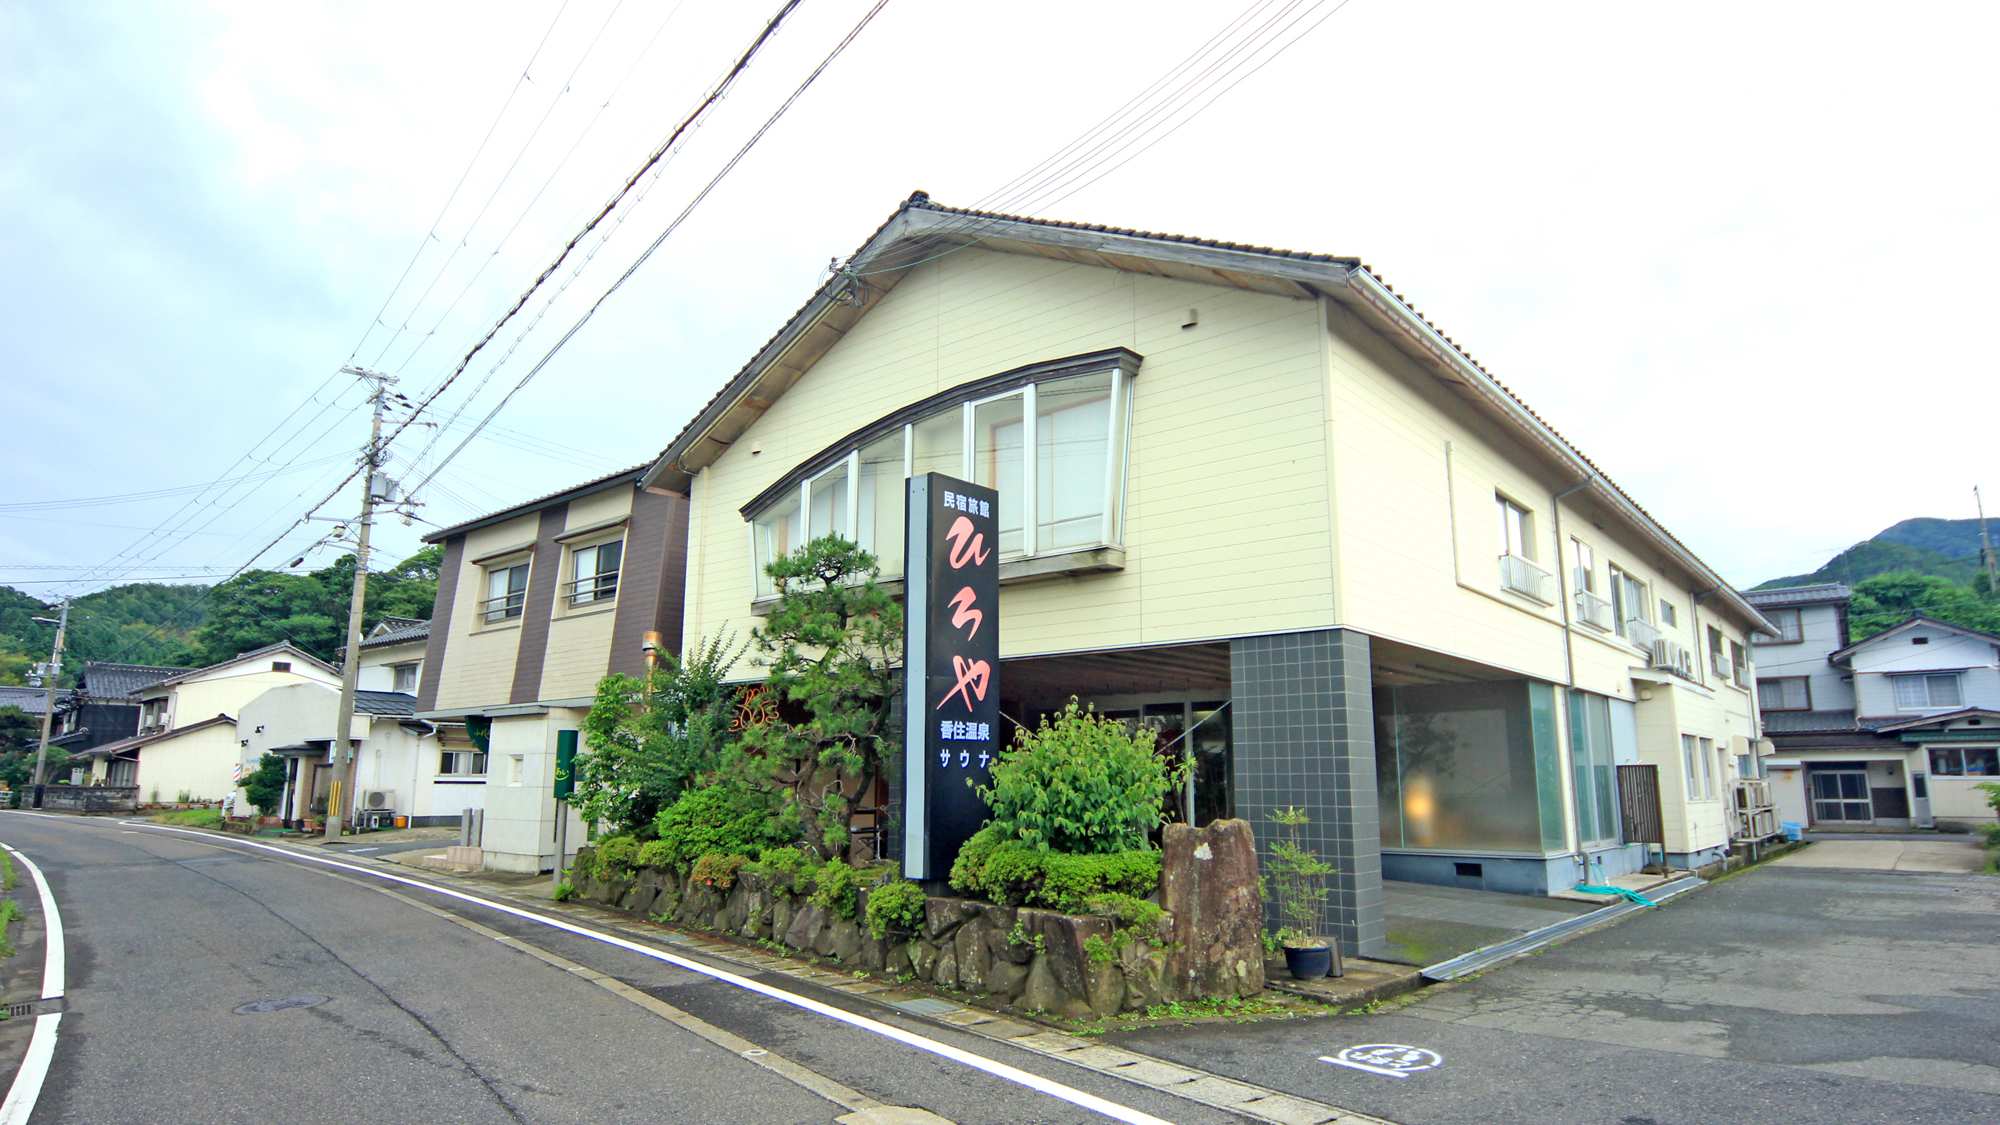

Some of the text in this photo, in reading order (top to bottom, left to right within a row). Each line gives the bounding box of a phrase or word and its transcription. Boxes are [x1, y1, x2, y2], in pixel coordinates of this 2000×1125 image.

[943, 490, 990, 519] 民宿旅館
[936, 515, 991, 713] ひろや
[940, 720, 990, 741] 香住温泉
[940, 748, 990, 768] サウナ
